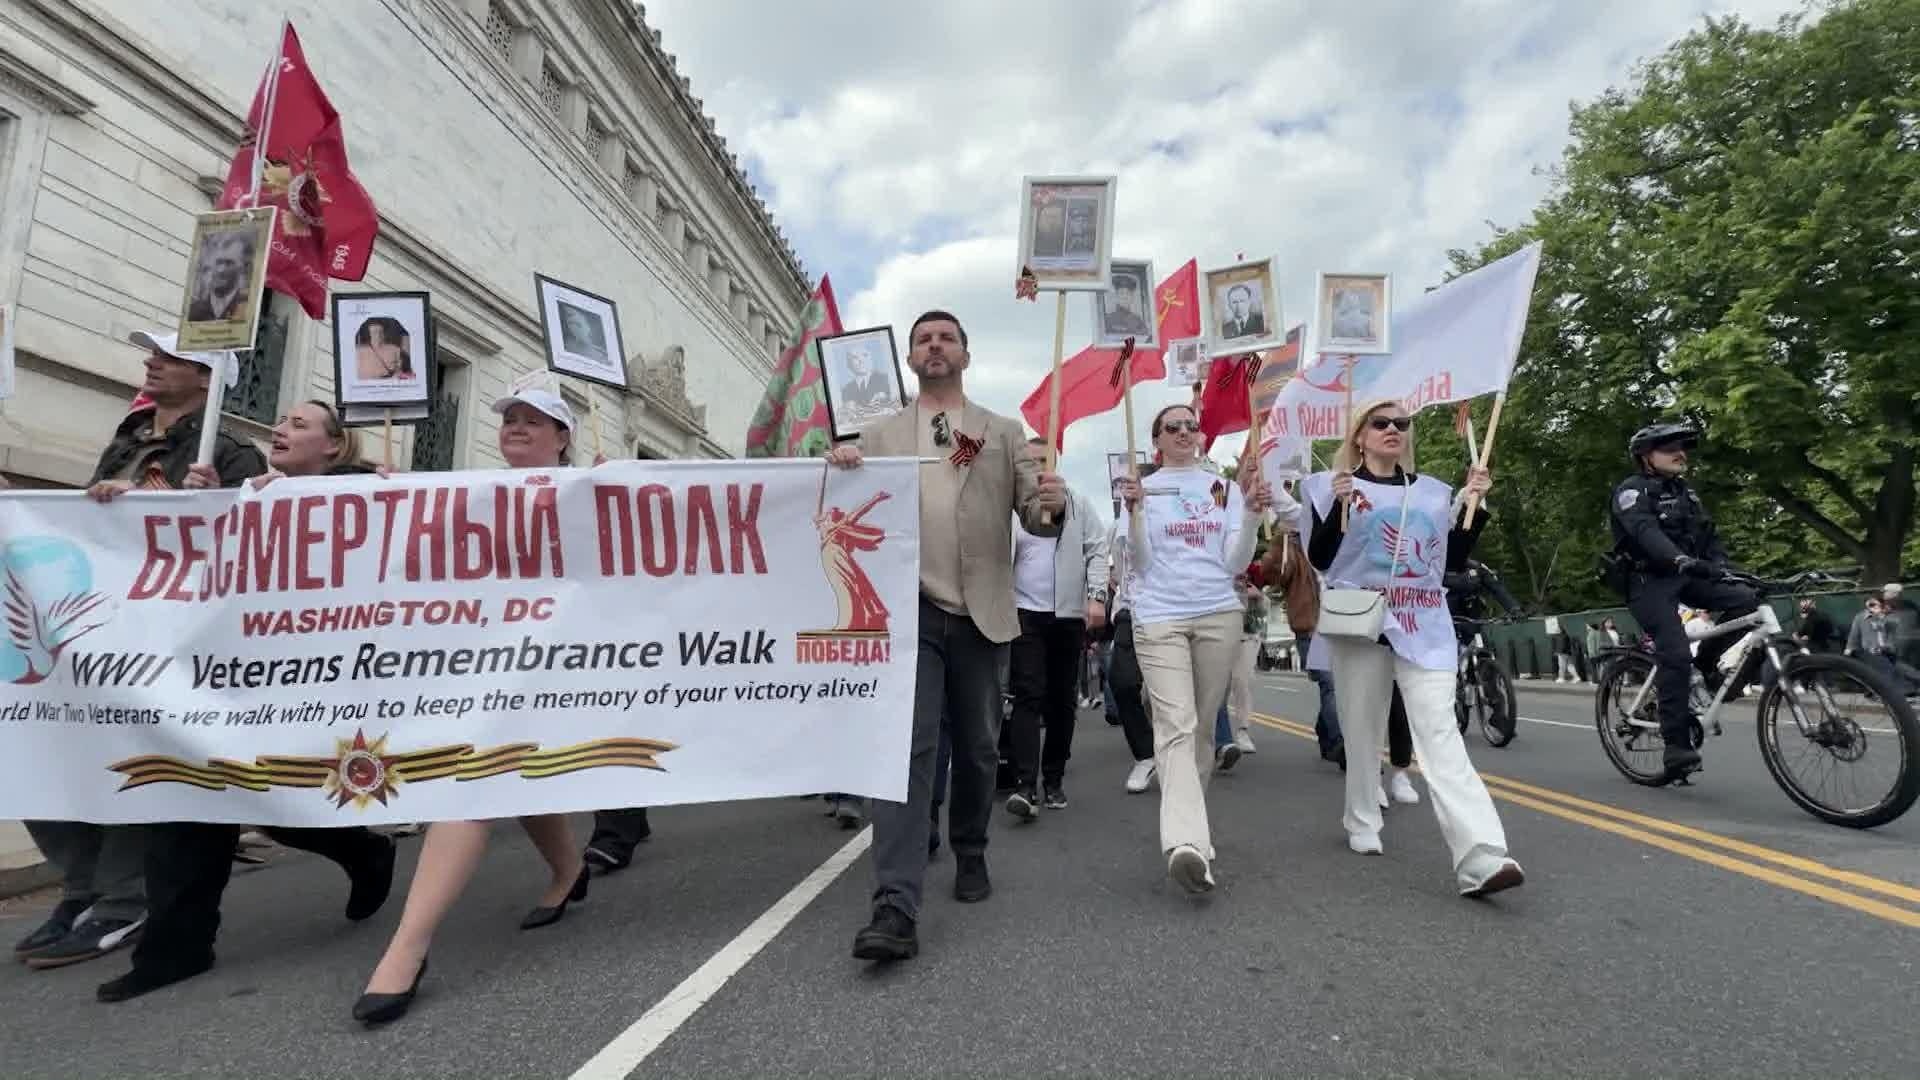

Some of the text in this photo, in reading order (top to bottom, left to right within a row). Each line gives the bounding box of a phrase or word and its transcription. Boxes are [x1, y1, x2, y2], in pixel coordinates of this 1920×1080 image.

[594, 484, 768, 577] ПОЛК
[242, 597, 555, 637] WASHINGTON, DC
[72, 629, 776, 689] WWII Veterans Remembrance Walk
[796, 639, 891, 666] ПОБЕДА!
[0, 701, 31, 721] rld
[36, 702, 61, 721] War
[64, 703, 84, 722] Two
[88, 703, 163, 725] Veterans
[182, 709, 219, 726] we
[225, 703, 277, 726] walk
[280, 700, 323, 724] with
[327, 702, 369, 726] you
[377, 698, 405, 719] to
[414, 695, 473, 719] keep
[482, 689, 525, 711] the
[533, 688, 638, 712] memory
[644, 682, 672, 705] of
[674, 687, 727, 708] your
[735, 681, 812, 704] victory
[817, 677, 878, 699] alive!
